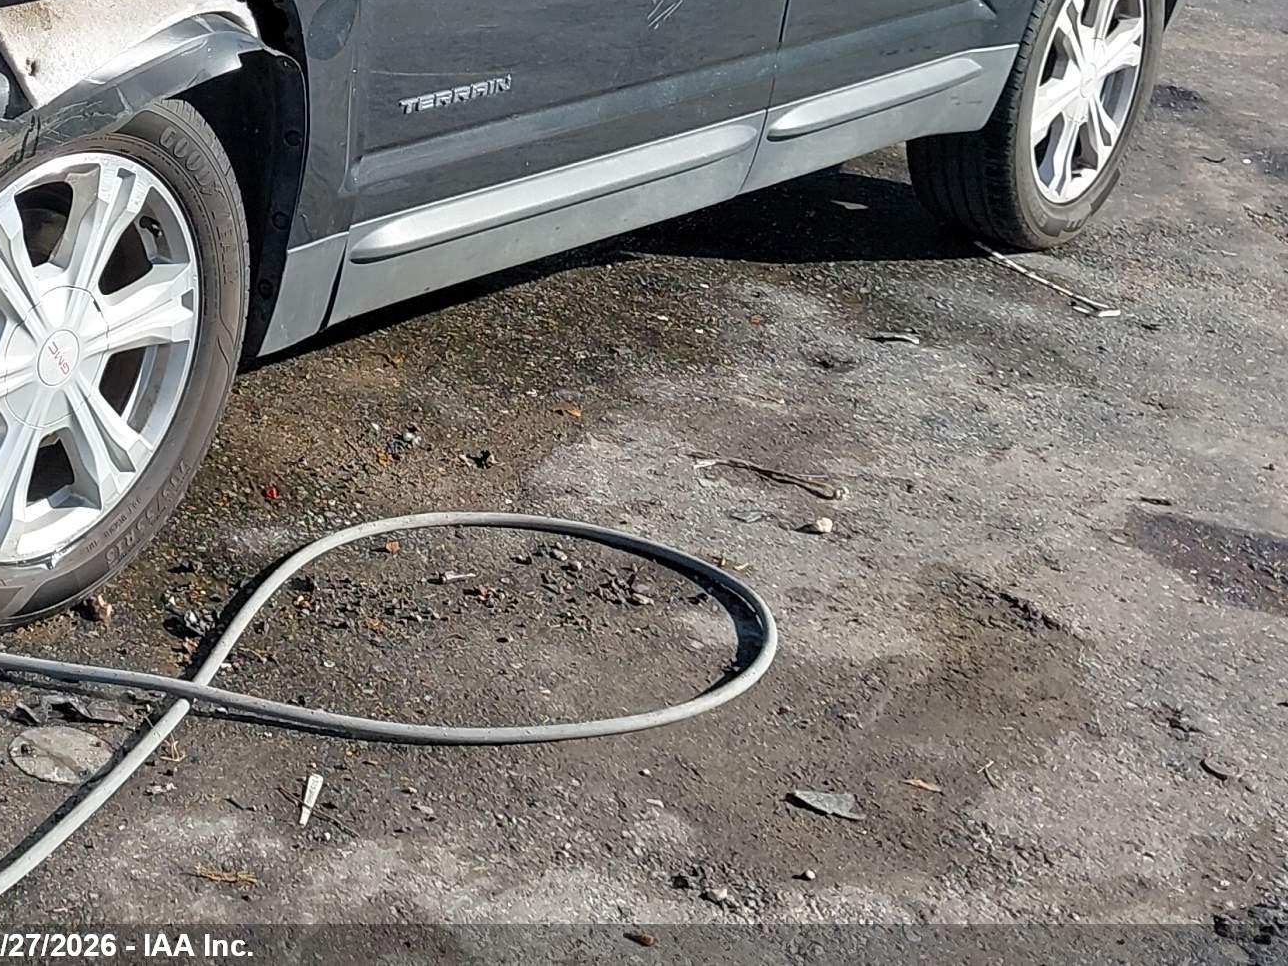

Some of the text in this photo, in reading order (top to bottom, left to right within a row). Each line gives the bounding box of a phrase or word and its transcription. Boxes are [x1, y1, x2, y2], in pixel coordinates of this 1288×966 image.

[399, 73, 512, 114] TERRAIN
[159, 126, 234, 284] GOODYEAR
[48, 341, 70, 375] GMC
